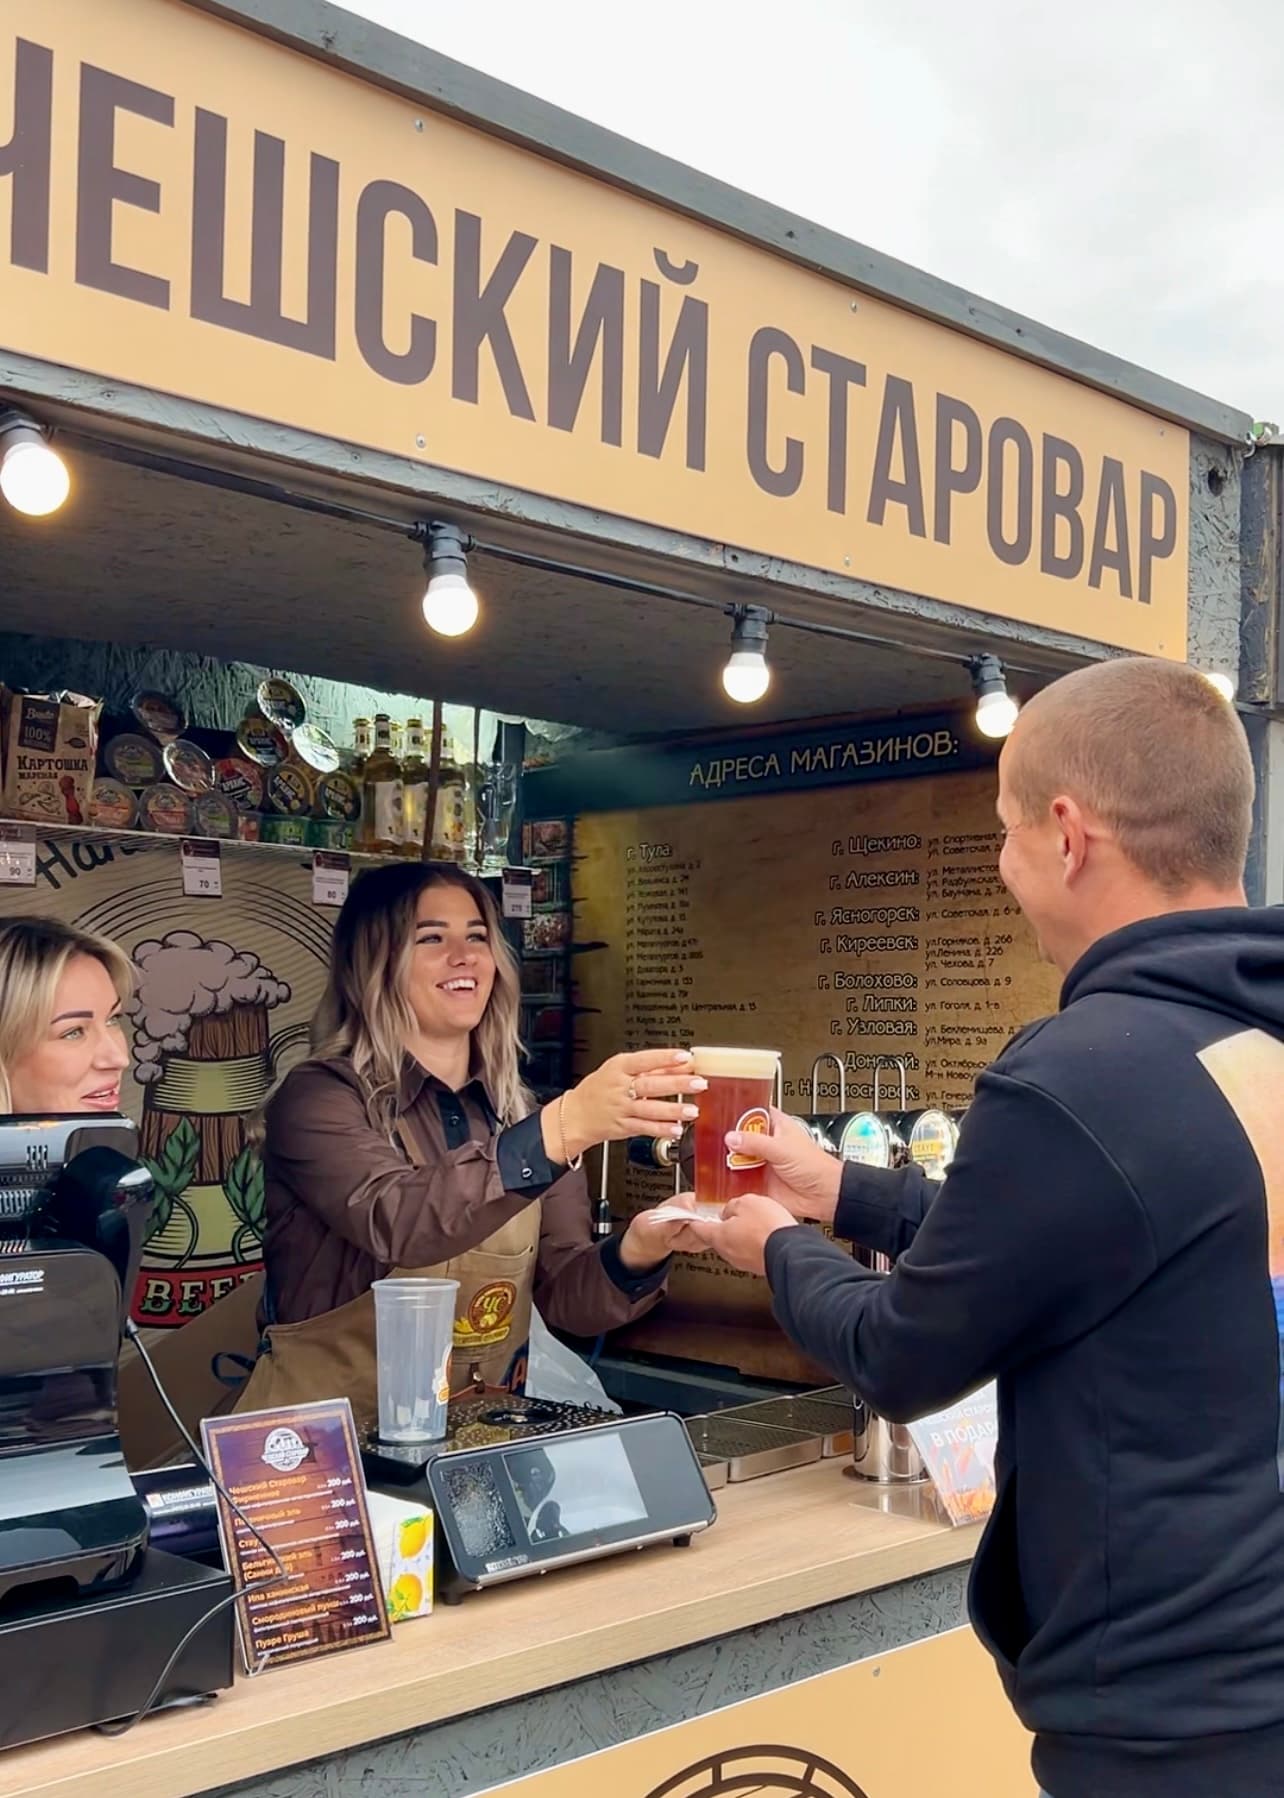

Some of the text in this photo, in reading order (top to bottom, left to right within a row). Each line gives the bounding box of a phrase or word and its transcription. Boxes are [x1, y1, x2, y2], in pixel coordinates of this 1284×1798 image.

[748, 326, 1177, 604] СТАРОВАР
[689, 731, 959, 788] АДРЕСА МАГАЗИНОВ:
[849, 834, 921, 856] Щекино:
[845, 870, 919, 889] Алексин:
[830, 907, 919, 928] Ясногорск:
[836, 935, 918, 957] Киреевск:
[989, 958, 995, 967] 7
[834, 972, 918, 989] Болохово:
[1005, 976, 1012, 986] 9
[862, 993, 917, 1012] Липки:
[846, 1017, 917, 1036] Узловая:
[141, 1273, 258, 1315] BEE
[945, 1423, 995, 1444] ПОДАР
